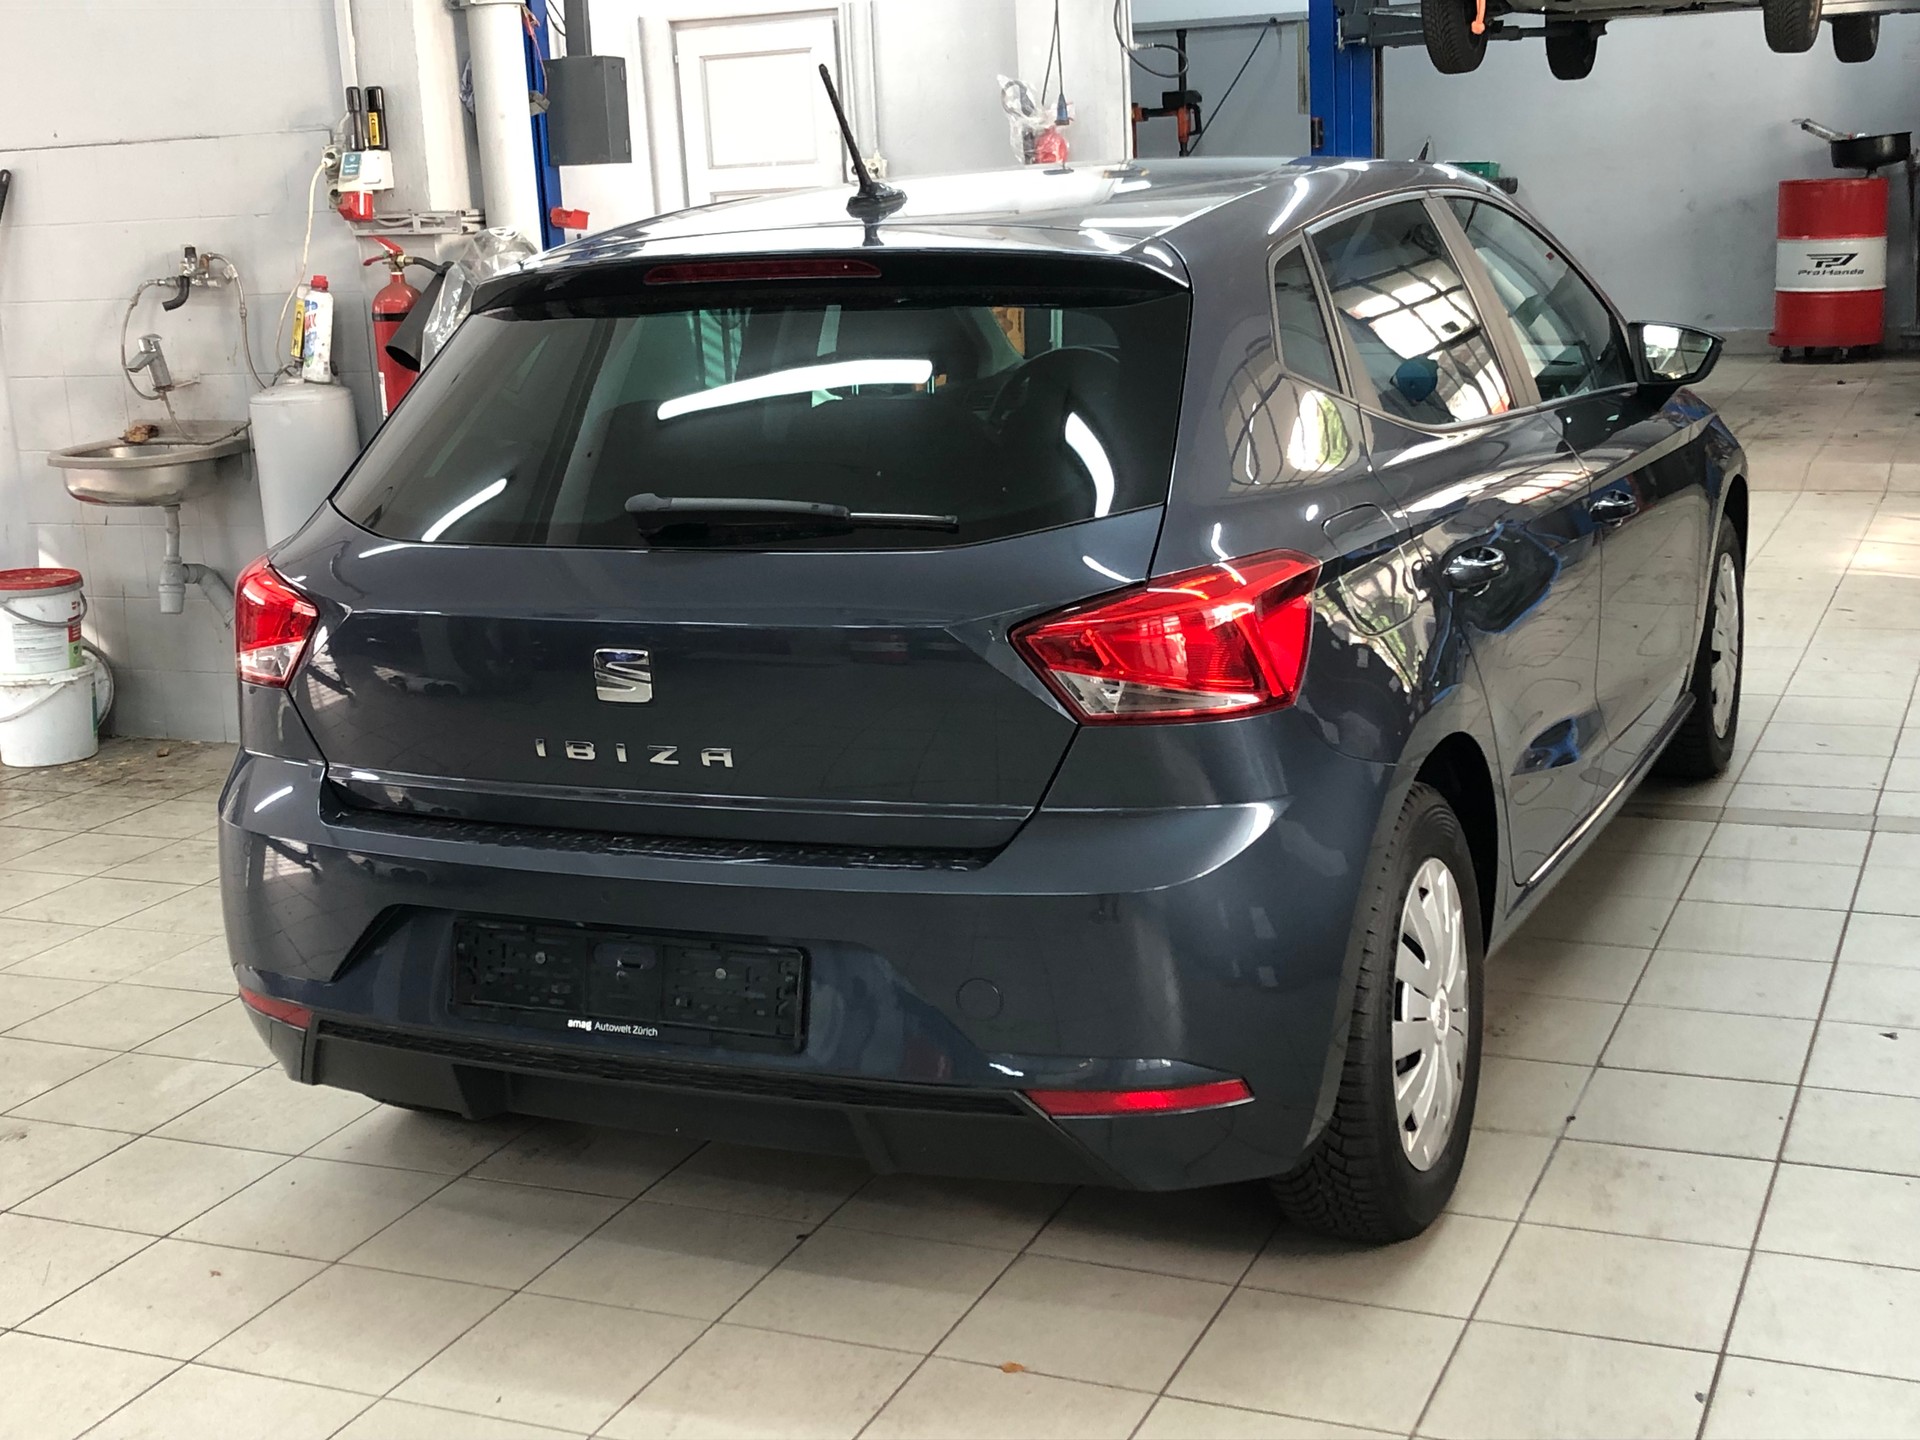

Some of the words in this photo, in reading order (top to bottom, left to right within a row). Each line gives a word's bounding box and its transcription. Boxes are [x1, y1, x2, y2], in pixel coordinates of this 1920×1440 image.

[535, 738, 734, 768] IBIZA
[567, 1019, 592, 1031] amag
[594, 1021, 631, 1034] Autowelt
[632, 1025, 658, 1037] Zürich
